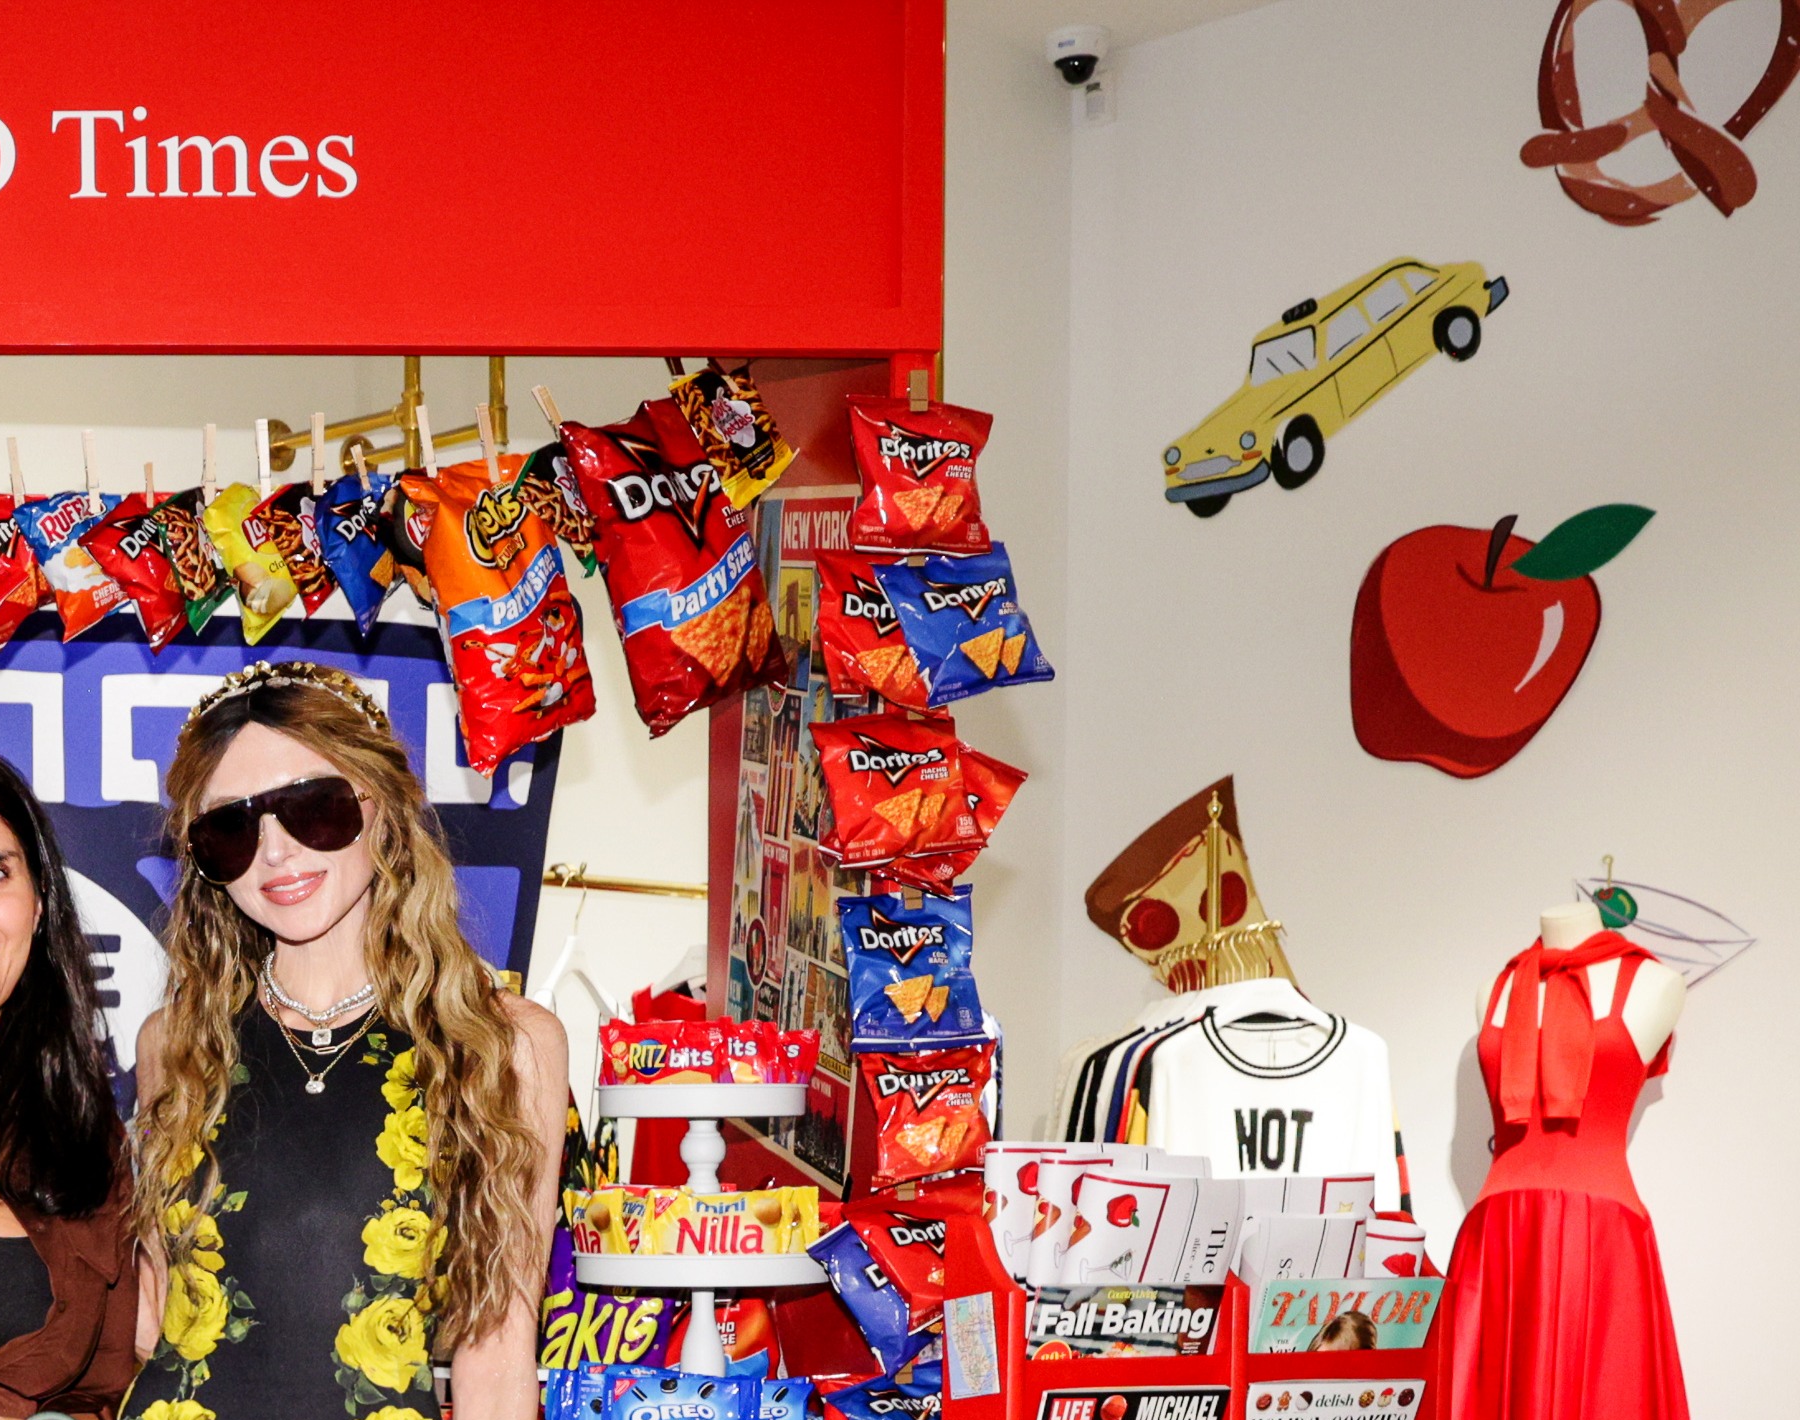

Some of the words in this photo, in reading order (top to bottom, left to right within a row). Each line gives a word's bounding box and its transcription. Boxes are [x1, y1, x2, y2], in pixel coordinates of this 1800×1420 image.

[50, 105, 359, 199] Times
[880, 437, 972, 460] Doritos
[947, 464, 973, 473] NACHO
[782, 511, 811, 551] NEW
[813, 508, 850, 551] YORK
[922, 576, 1007, 613] Doritos
[849, 748, 944, 772] Doritos
[920, 766, 949, 775] NACHO
[920, 772, 949, 781] CHEESE
[859, 923, 945, 951] Doritos
[627, 1042, 669, 1070] RITZ
[668, 1046, 715, 1069] bits
[1234, 1107, 1315, 1174] NOT
[694, 1197, 746, 1215] mini
[675, 1215, 765, 1255] Nilla
[1200, 1221, 1230, 1275] The
[1036, 1302, 1098, 1337] Fall
[1100, 1301, 1214, 1340] Baking
[1270, 1288, 1432, 1328] TAYLOR
[1315, 1393, 1354, 1409] delish
